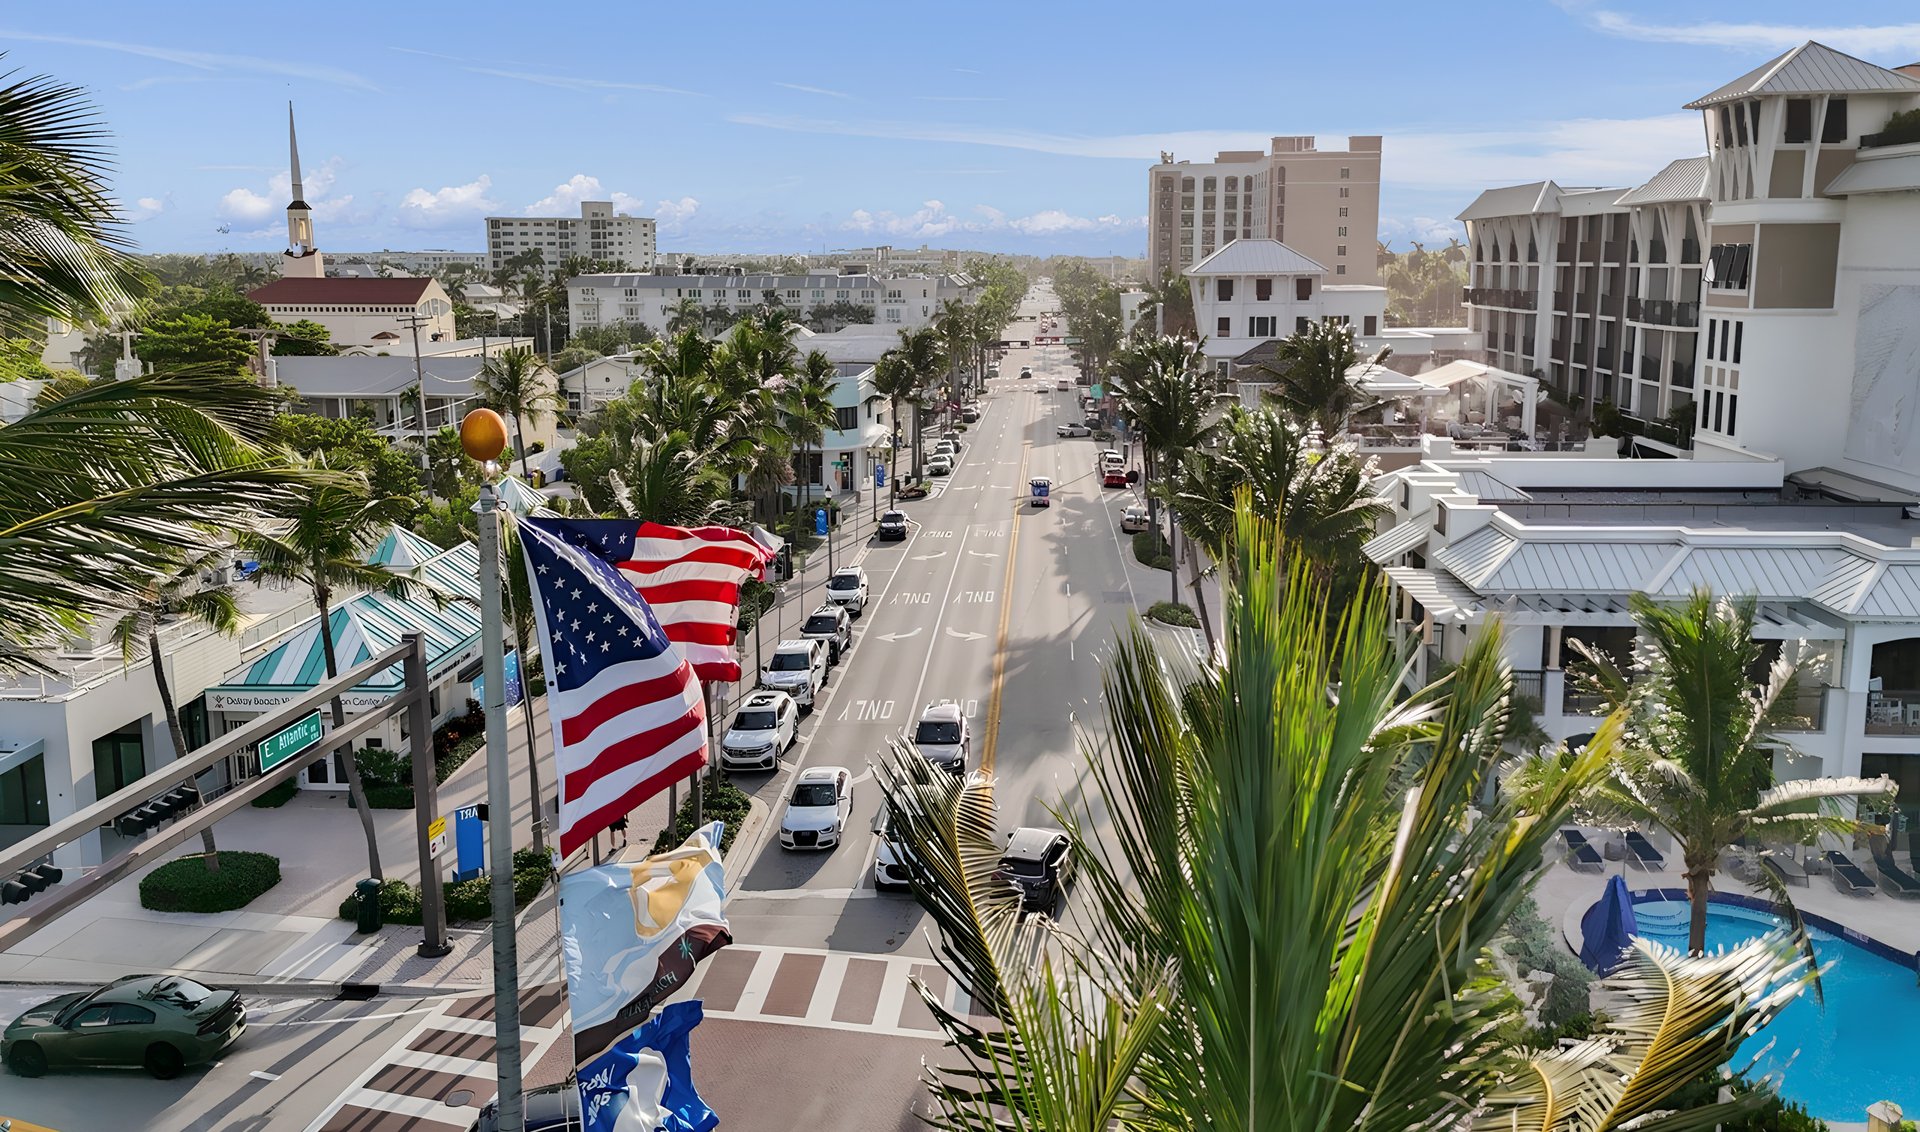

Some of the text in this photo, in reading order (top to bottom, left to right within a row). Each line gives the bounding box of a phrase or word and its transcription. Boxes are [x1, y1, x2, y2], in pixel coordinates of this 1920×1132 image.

[889, 592, 932, 604] ONLY
[953, 590, 995, 604] ONLY
[837, 700, 896, 721] ONLY
[264, 742, 275, 758] E
[278, 723, 309, 751] Atlantic
